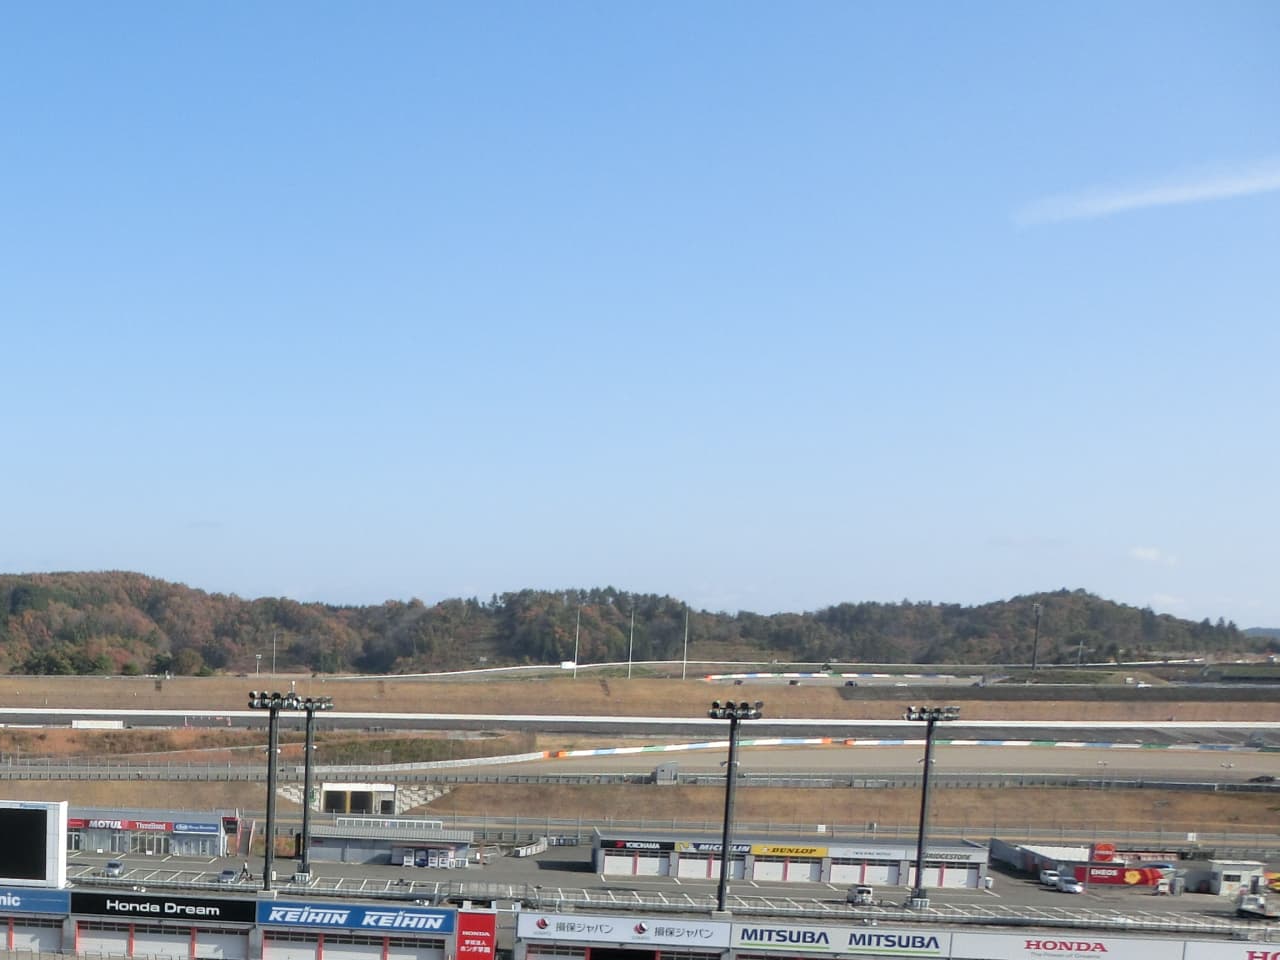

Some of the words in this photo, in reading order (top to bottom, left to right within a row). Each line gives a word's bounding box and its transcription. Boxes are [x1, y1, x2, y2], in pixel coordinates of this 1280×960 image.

[89, 820, 122, 829] MOTUL
[106, 899, 160, 913] Honda
[164, 902, 220, 916] Dream
[269, 905, 352, 925] KEIHIN
[361, 909, 446, 929] KEIHIN
[556, 922, 614, 934] 損保ジャパン
[654, 926, 713, 939] 損保ジャパン
[740, 928, 830, 945] MITSUBA
[848, 932, 940, 949] MITSUBA
[1024, 940, 1108, 953] HONDA
